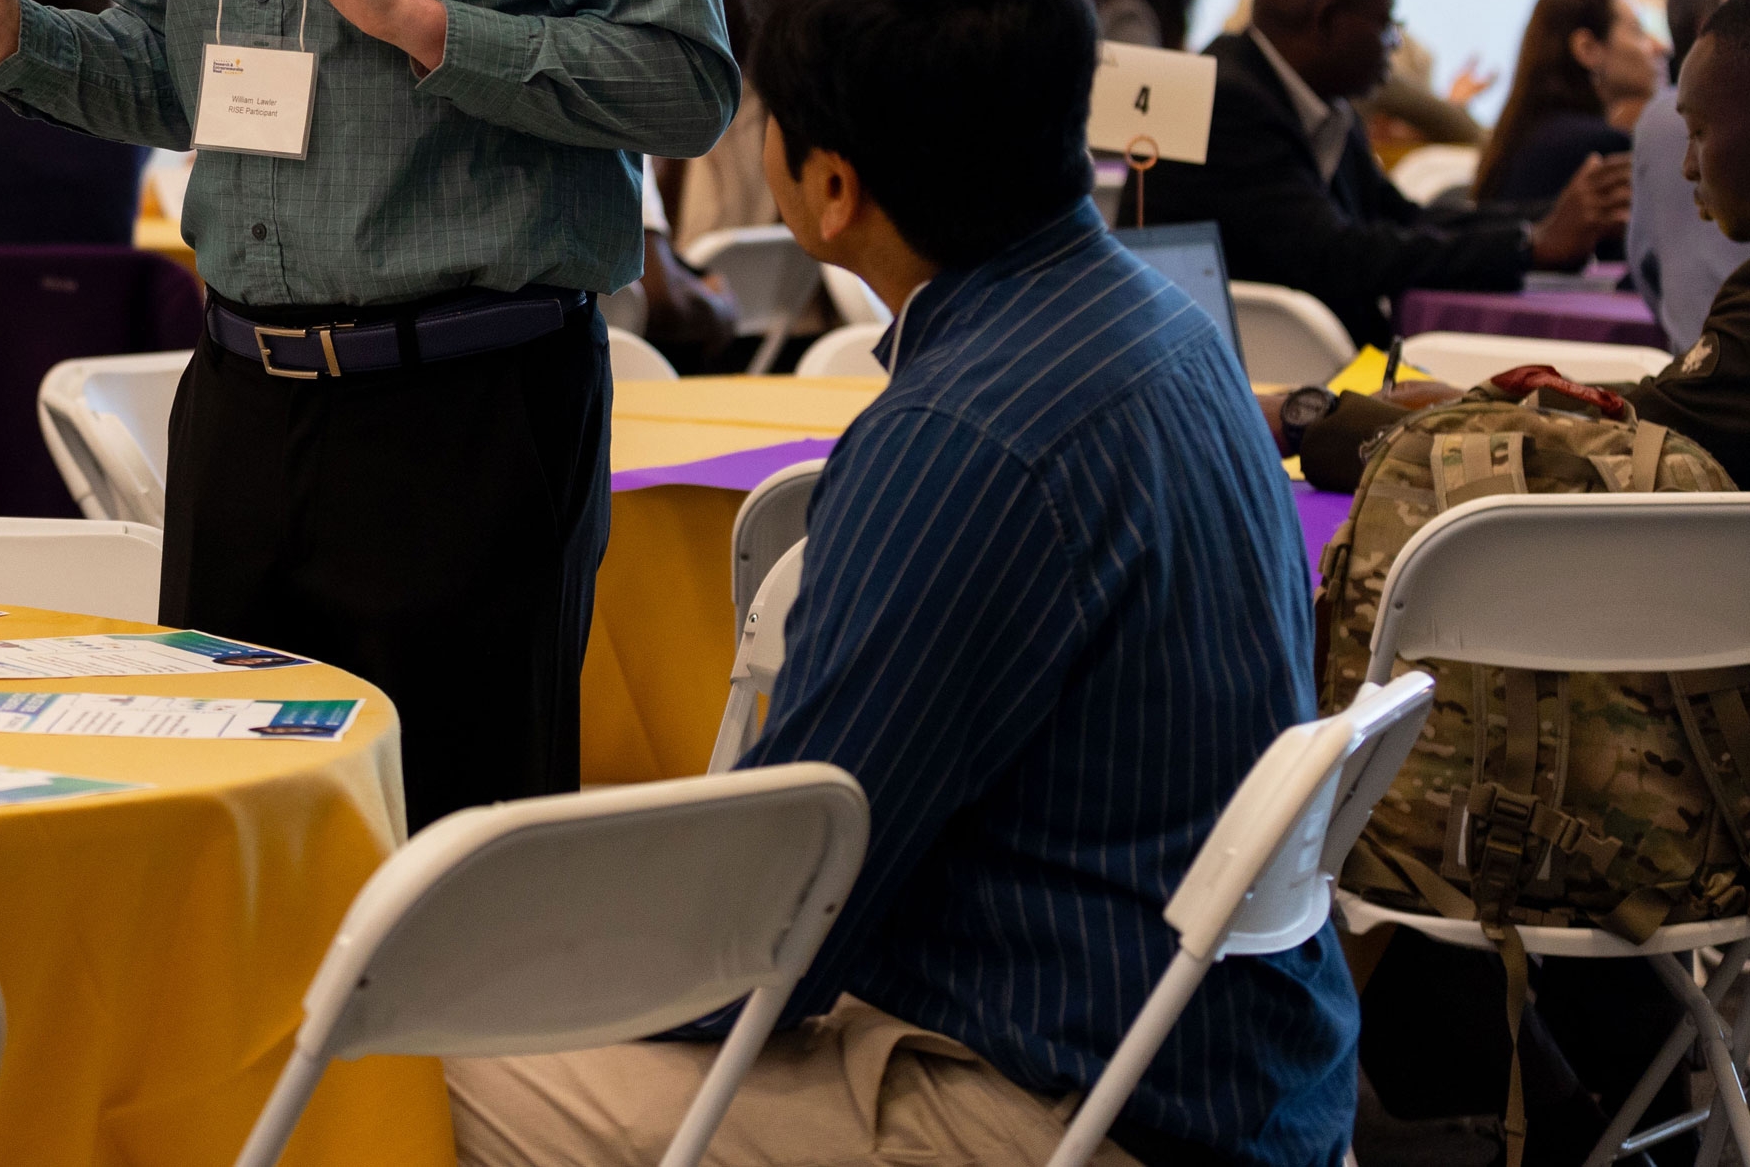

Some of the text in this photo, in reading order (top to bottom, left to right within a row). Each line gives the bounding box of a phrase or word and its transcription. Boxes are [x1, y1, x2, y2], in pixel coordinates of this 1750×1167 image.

[232, 95, 254, 104] William
[1134, 85, 1151, 116] 4
[228, 105, 278, 118] RISE Participant
